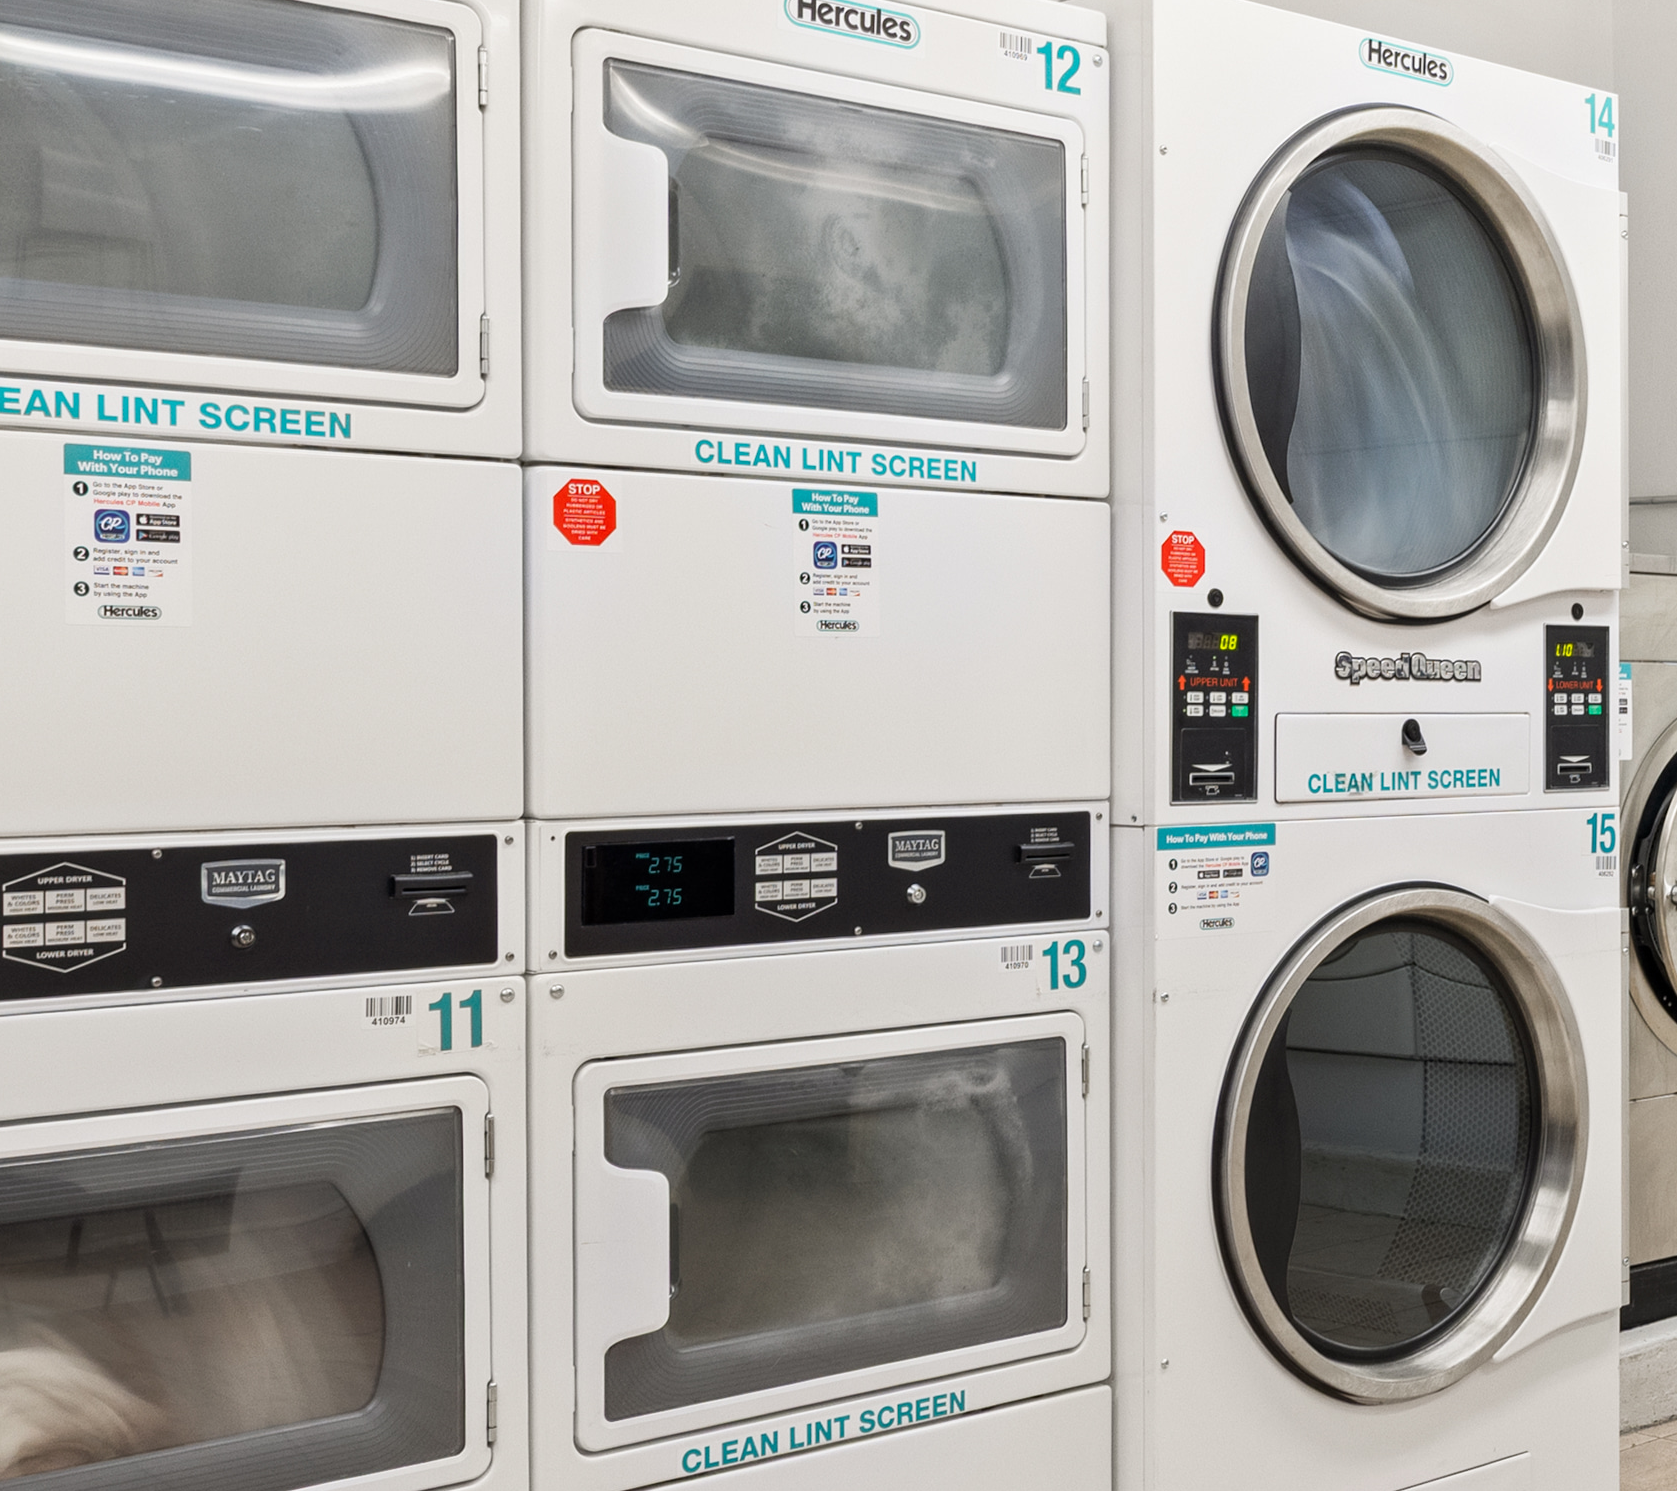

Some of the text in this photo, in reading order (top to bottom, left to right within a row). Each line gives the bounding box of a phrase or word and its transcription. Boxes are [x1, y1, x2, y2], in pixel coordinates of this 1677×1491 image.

[1036, 41, 1082, 97] 12
[1368, 39, 1448, 81] Hercules
[1585, 93, 1615, 137] 14
[97, 393, 185, 429] LINT
[198, 402, 354, 440] SCREEN
[695, 440, 978, 483] CLEAN LINT SCREEN
[567, 483, 602, 497] STOP
[1220, 635, 1237, 650] 08
[1335, 651, 1482, 685] Speed Queen
[1190, 677, 1238, 687] UPPER UNIT
[1556, 681, 1594, 689] LOWER UNIT
[1308, 769, 1501, 794] CLEAN LINT SCREEN
[1587, 813, 1616, 853] 15
[894, 839, 940, 853] MAYTAG
[212, 869, 277, 886] MAYTAG
[648, 856, 683, 874] 2.75
[1202, 918, 1232, 928] Hercules
[1005, 961, 1030, 970] 410970
[1042, 938, 1088, 991] 13
[371, 1016, 406, 1027] 410974
[428, 988, 484, 1052] 11
[681, 1390, 966, 1473] CLEAN LINT SCREEN
